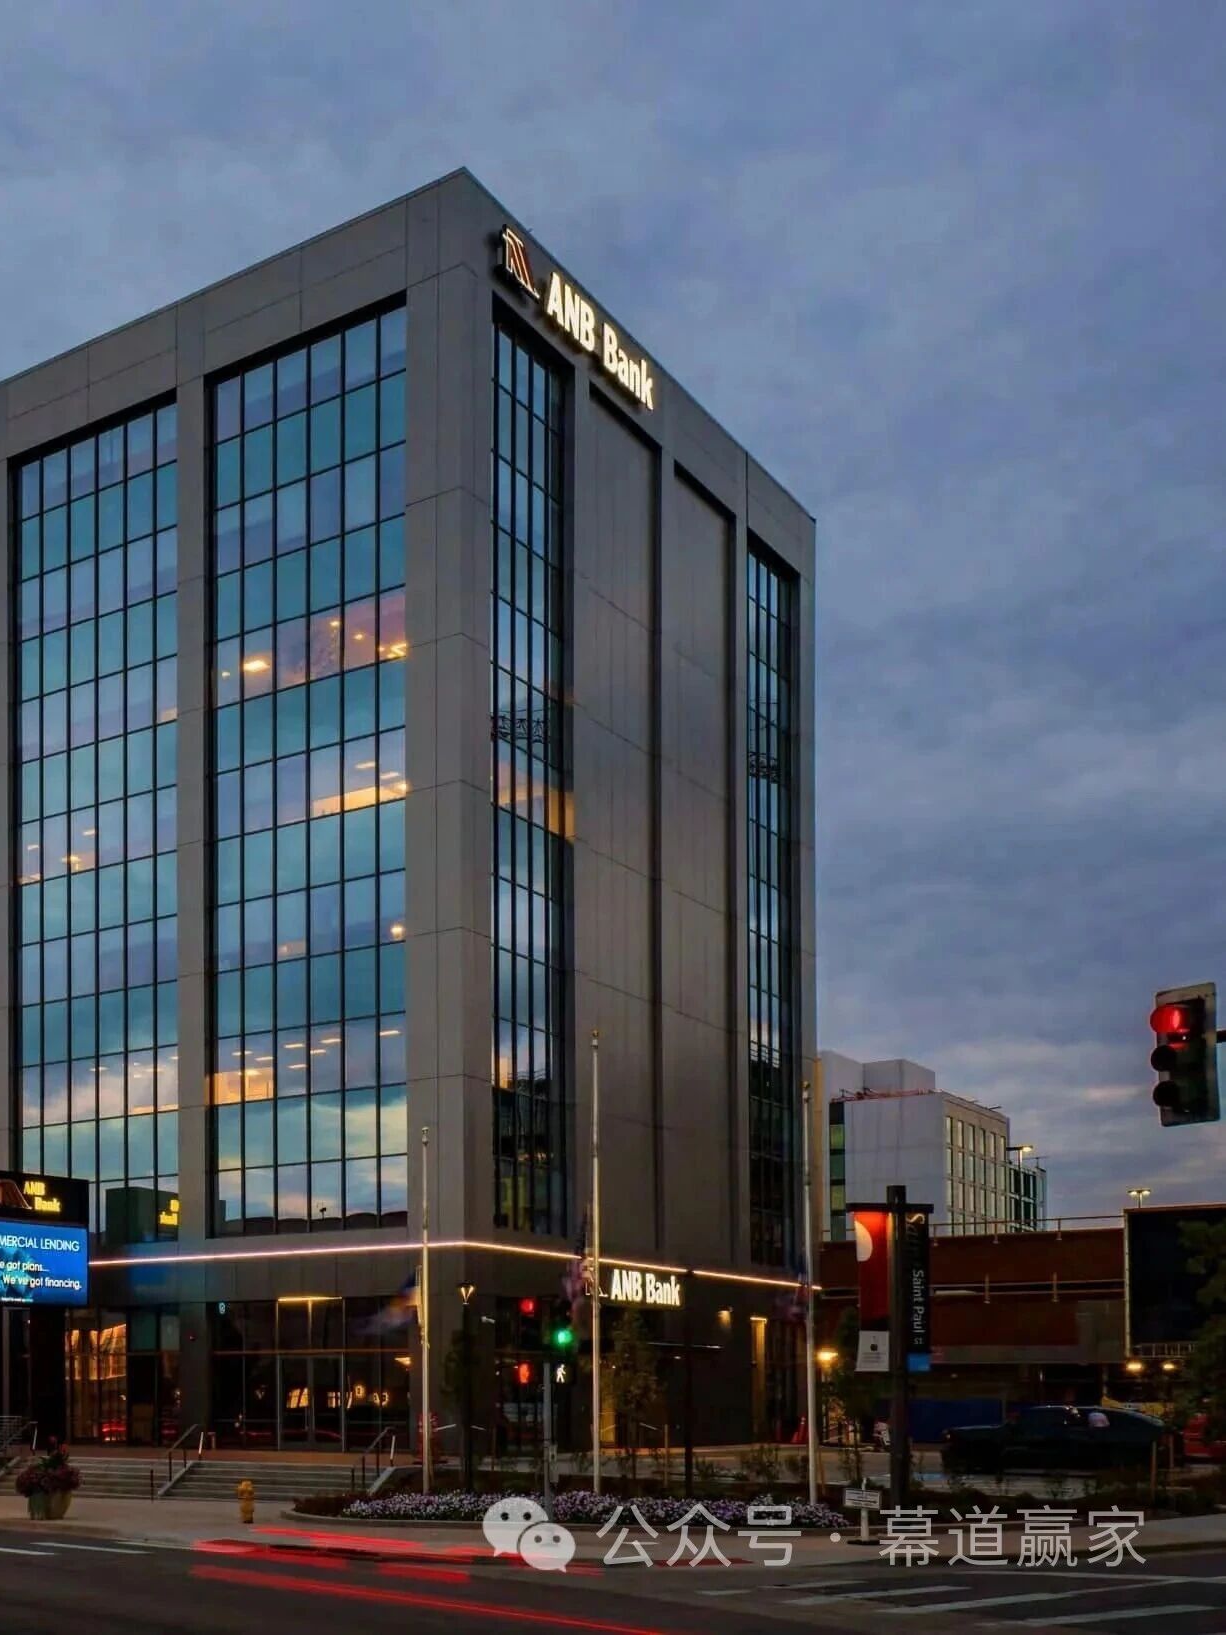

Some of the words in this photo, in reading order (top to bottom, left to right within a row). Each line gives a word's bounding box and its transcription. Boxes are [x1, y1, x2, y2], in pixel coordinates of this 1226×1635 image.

[546, 271, 595, 352] ANB
[603, 322, 654, 411] Bank
[23, 1181, 46, 1196] ANB
[34, 1196, 61, 1212] Bank
[40, 1237, 80, 1252] LENDING
[6, 1261, 21, 1271] got
[2, 1274, 29, 1285] We've
[29, 1278, 43, 1287] got
[45, 1276, 82, 1290] financing.
[611, 1268, 643, 1302] ANB
[645, 1272, 681, 1306] Bank
[912, 1269, 925, 1304] Saint
[912, 1305, 926, 1333] Paul
